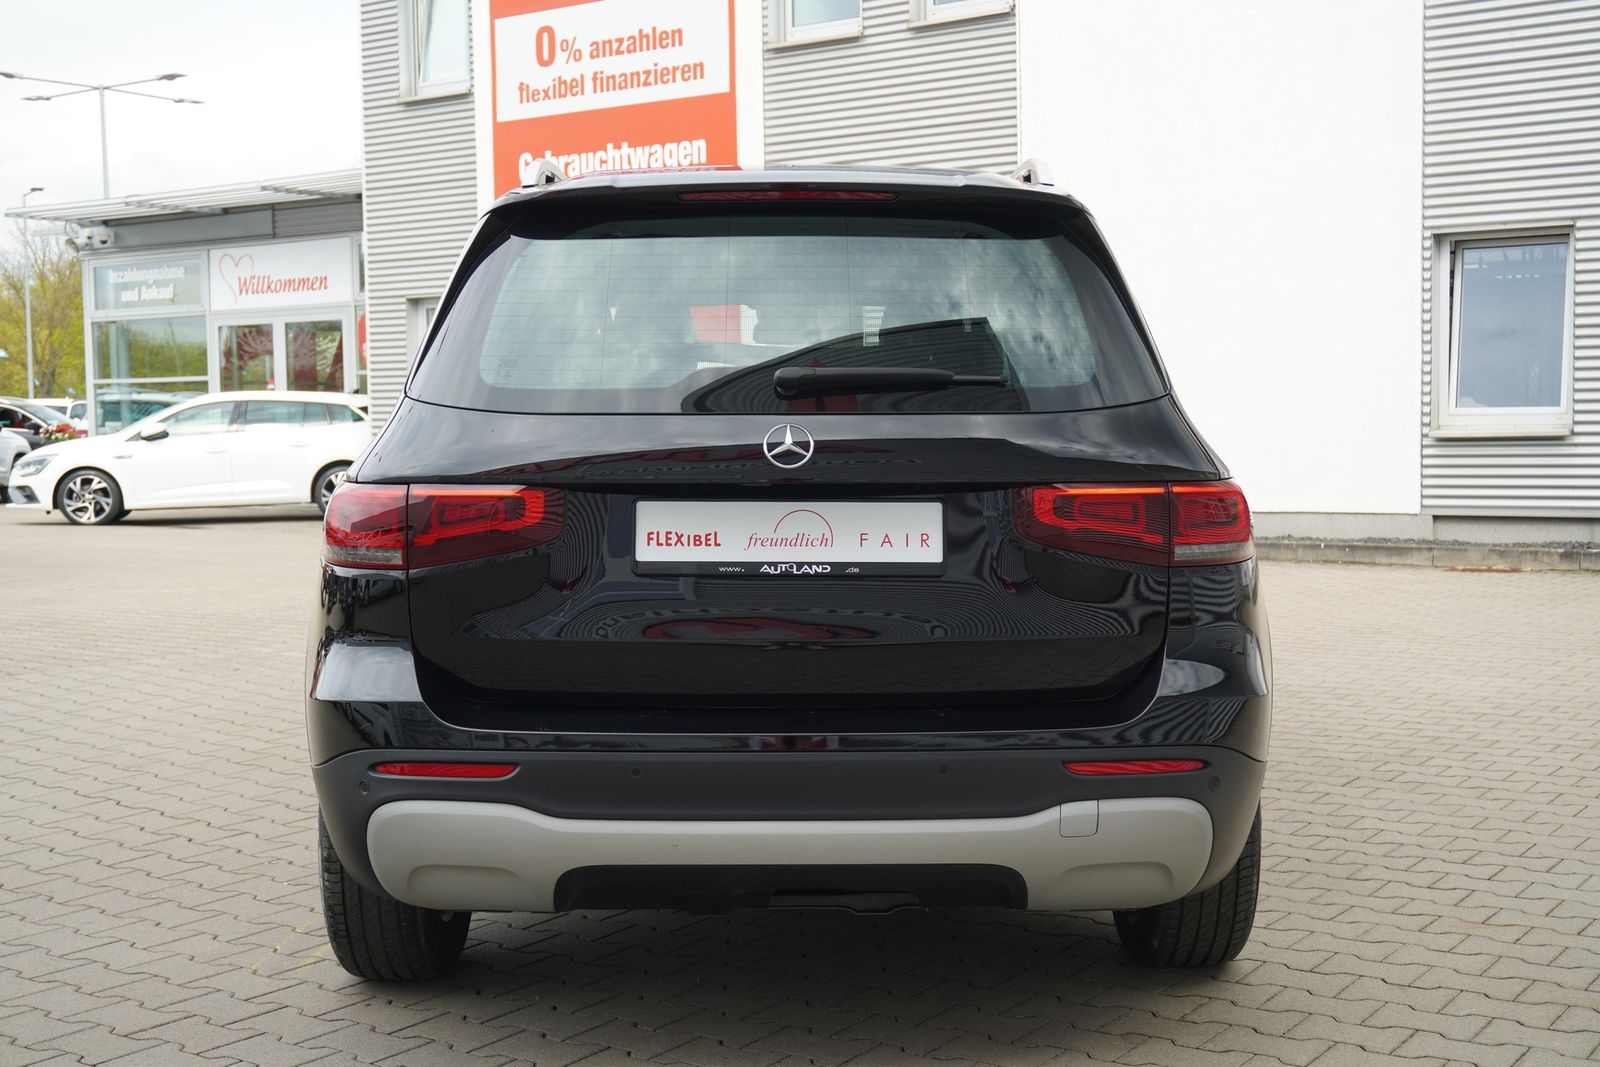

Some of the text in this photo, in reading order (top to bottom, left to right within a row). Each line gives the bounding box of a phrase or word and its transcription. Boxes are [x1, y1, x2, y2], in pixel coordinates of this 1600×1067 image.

[589, 27, 684, 60] anzahlen
[518, 61, 706, 104] flexibel finanzieren
[518, 138, 707, 179] Grauchtwagen
[237, 273, 329, 297] Willkommen
[646, 530, 931, 551] FLEXIBEL freundlich FAIR
[759, 562, 832, 575] AUTOLAND
